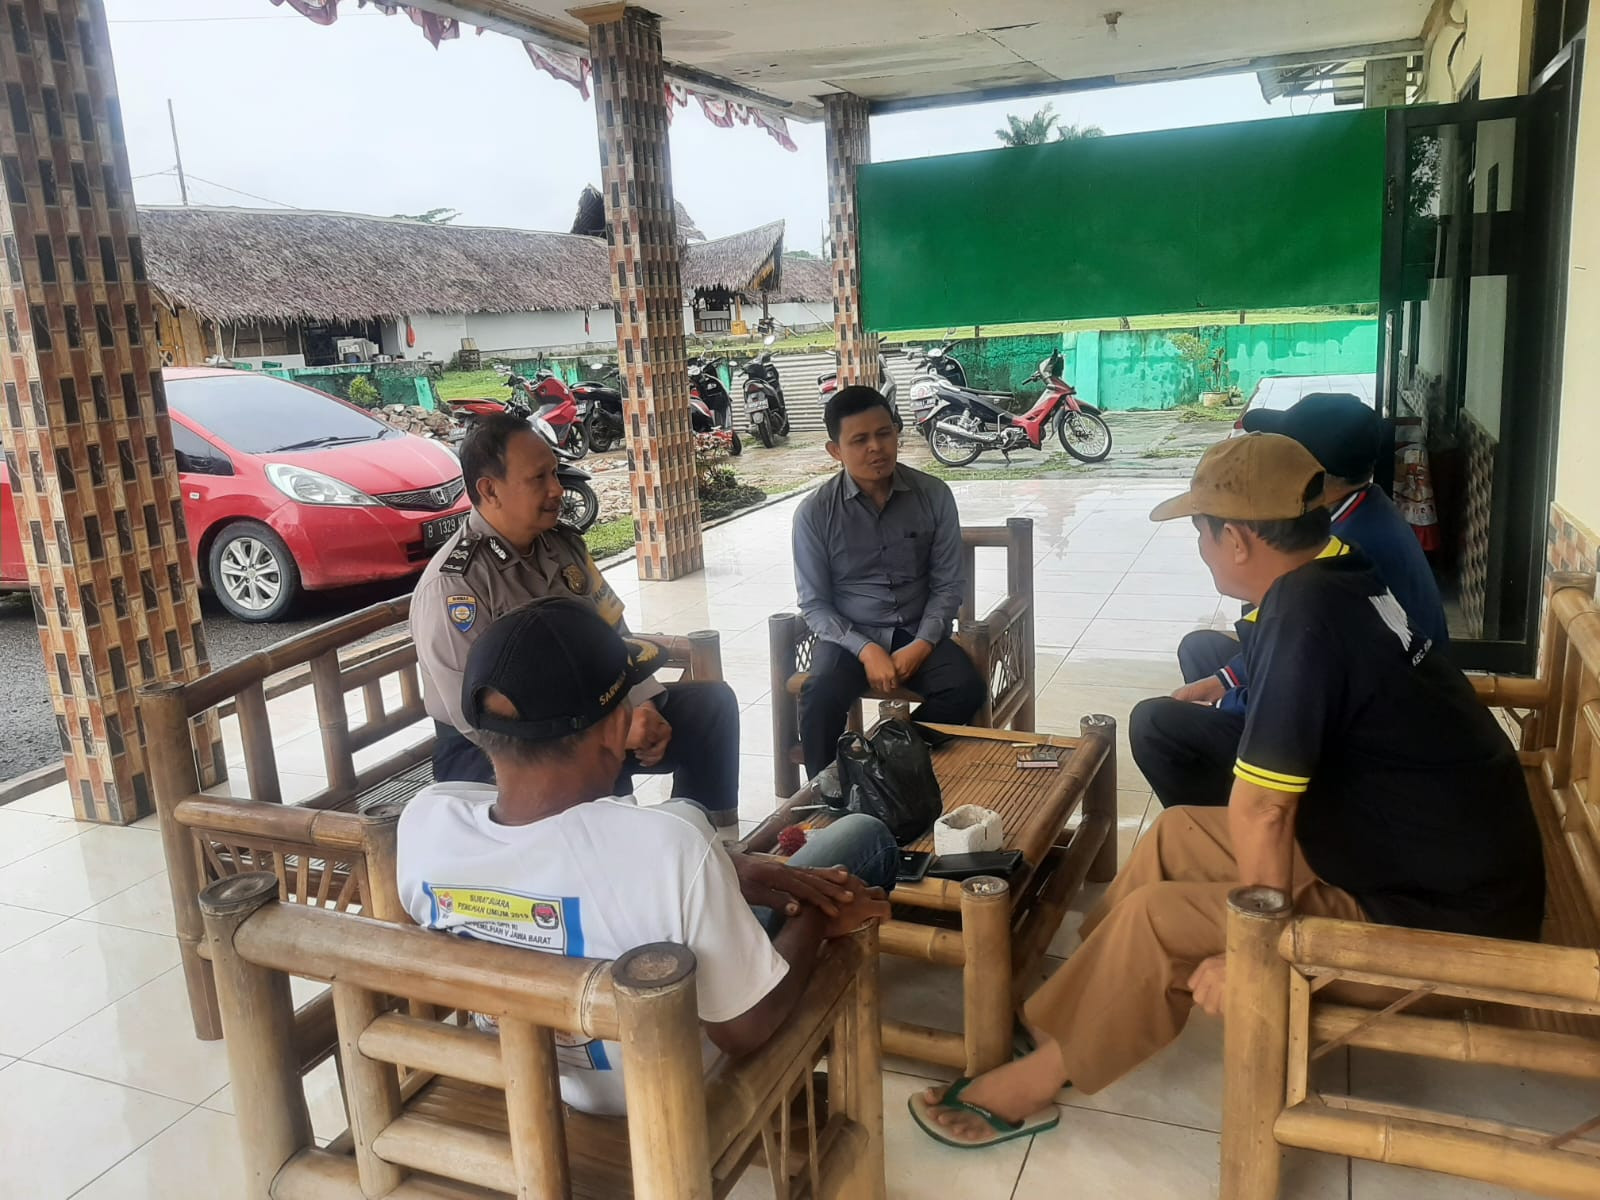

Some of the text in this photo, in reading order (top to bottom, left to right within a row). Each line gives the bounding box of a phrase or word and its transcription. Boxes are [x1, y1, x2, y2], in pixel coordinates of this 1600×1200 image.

[428, 525, 433, 538] B
[439, 518, 456, 535] 1329
[470, 894, 510, 909] SURAT SUARA
[486, 908, 510, 918] UMUM
[510, 911, 530, 920] 2019
[509, 930, 527, 942] JAWA
[528, 934, 552, 945] BARAT
